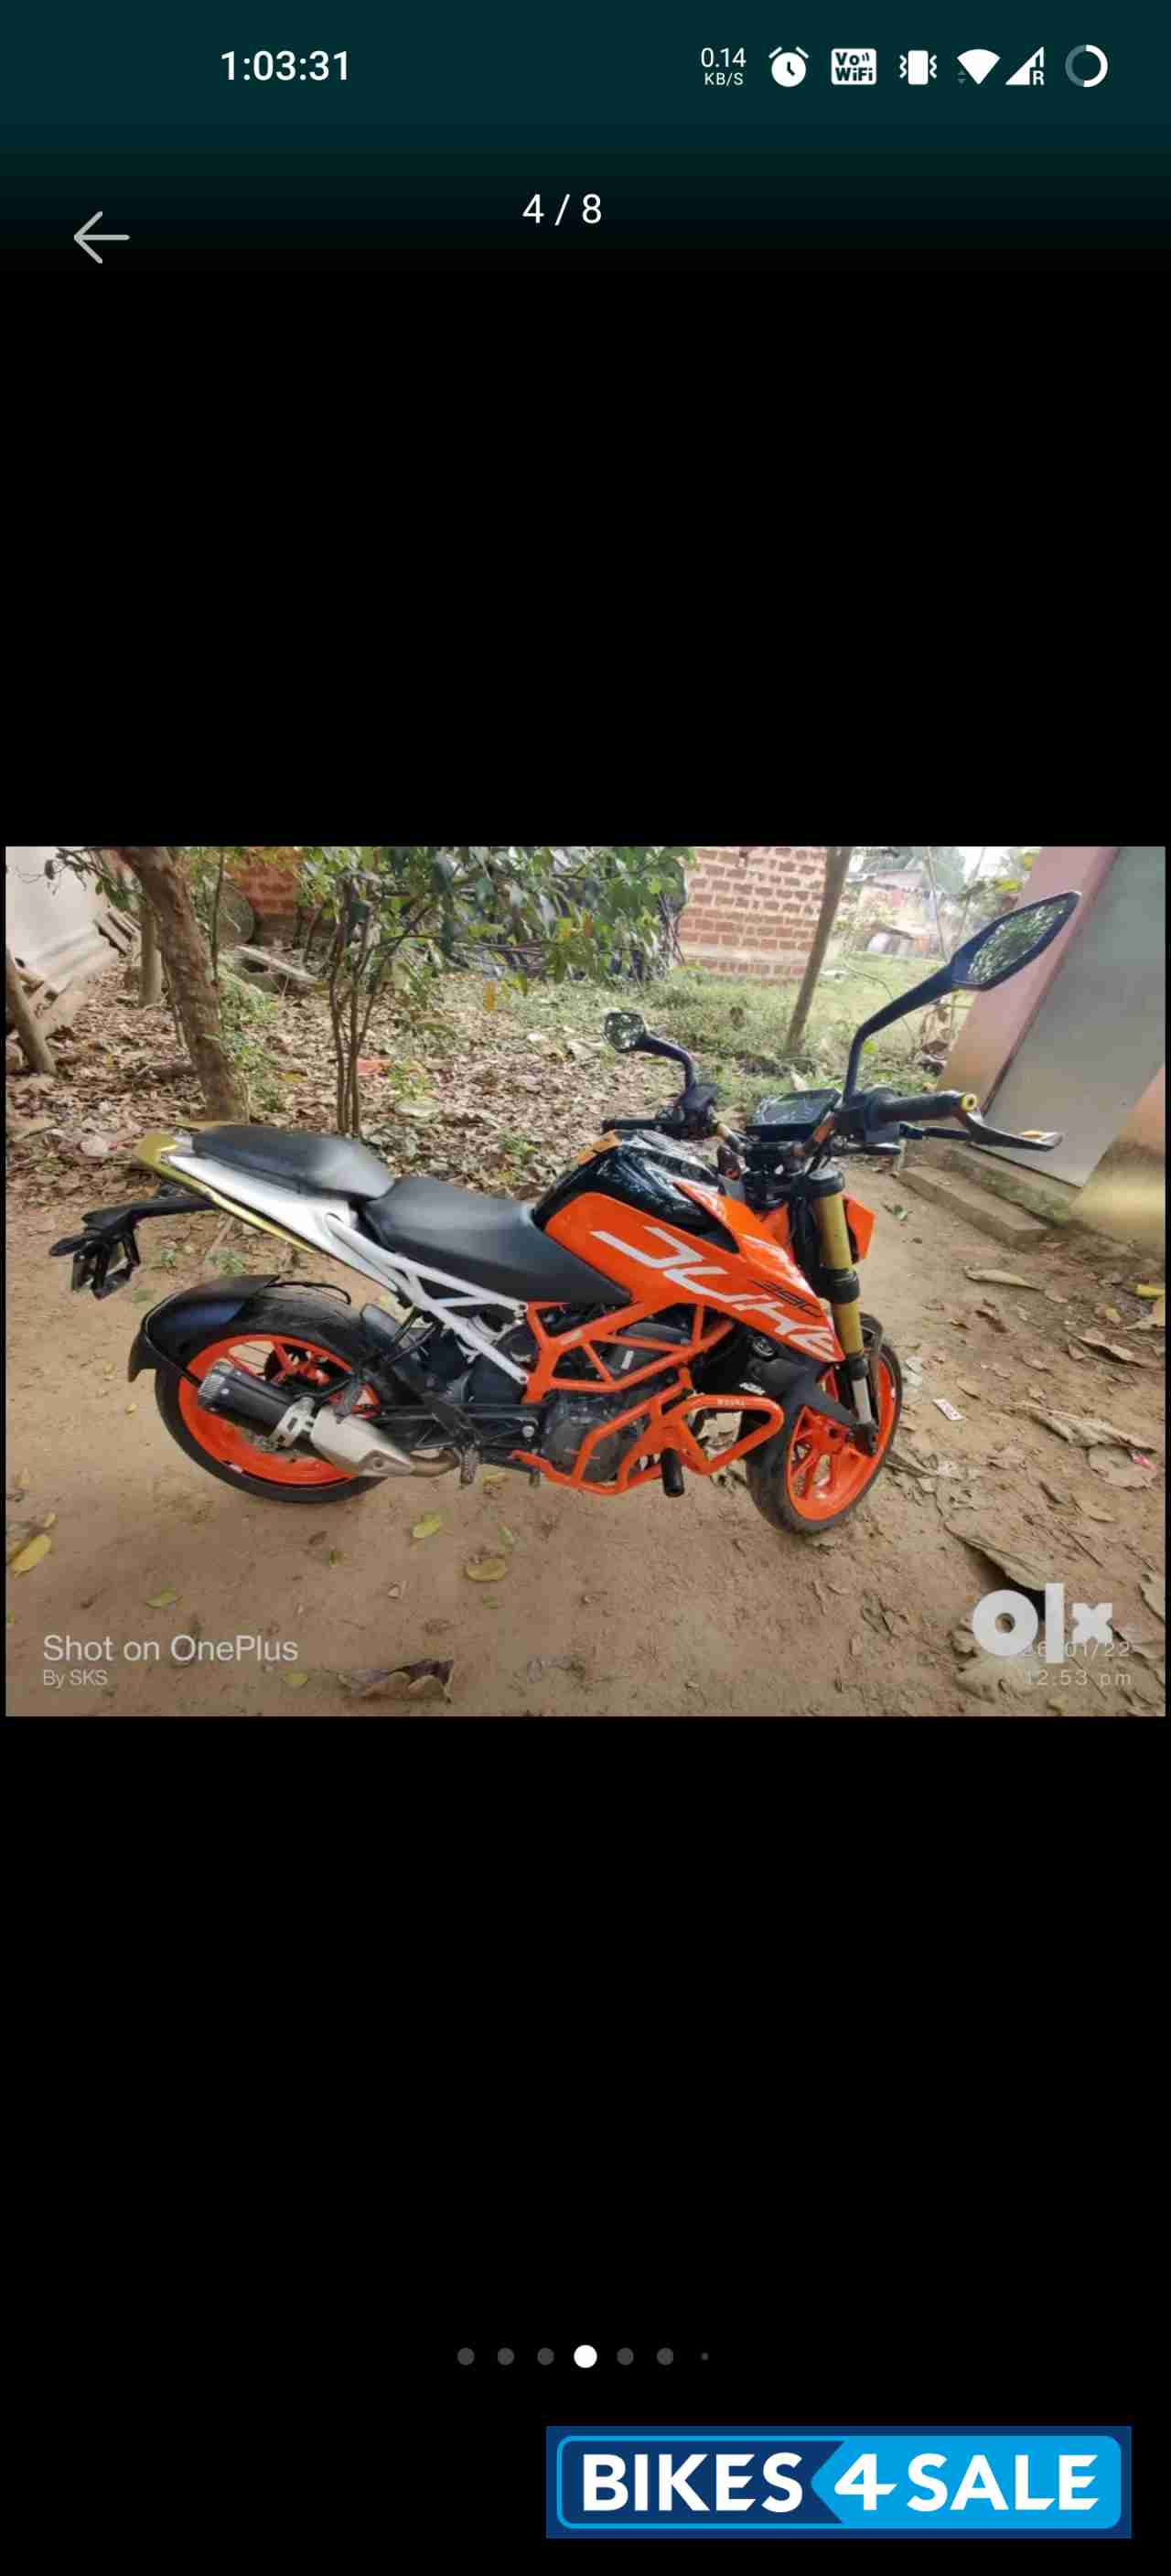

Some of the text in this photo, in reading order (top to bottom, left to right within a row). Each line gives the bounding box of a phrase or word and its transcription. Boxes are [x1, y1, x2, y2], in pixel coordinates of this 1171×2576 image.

[221, 50, 348, 81] 1:03:31
[701, 48, 747, 68] 0.14
[704, 72, 744, 86] KB/S
[834, 68, 874, 82] WiFi
[522, 194, 545, 224] 4
[582, 194, 602, 224] 8
